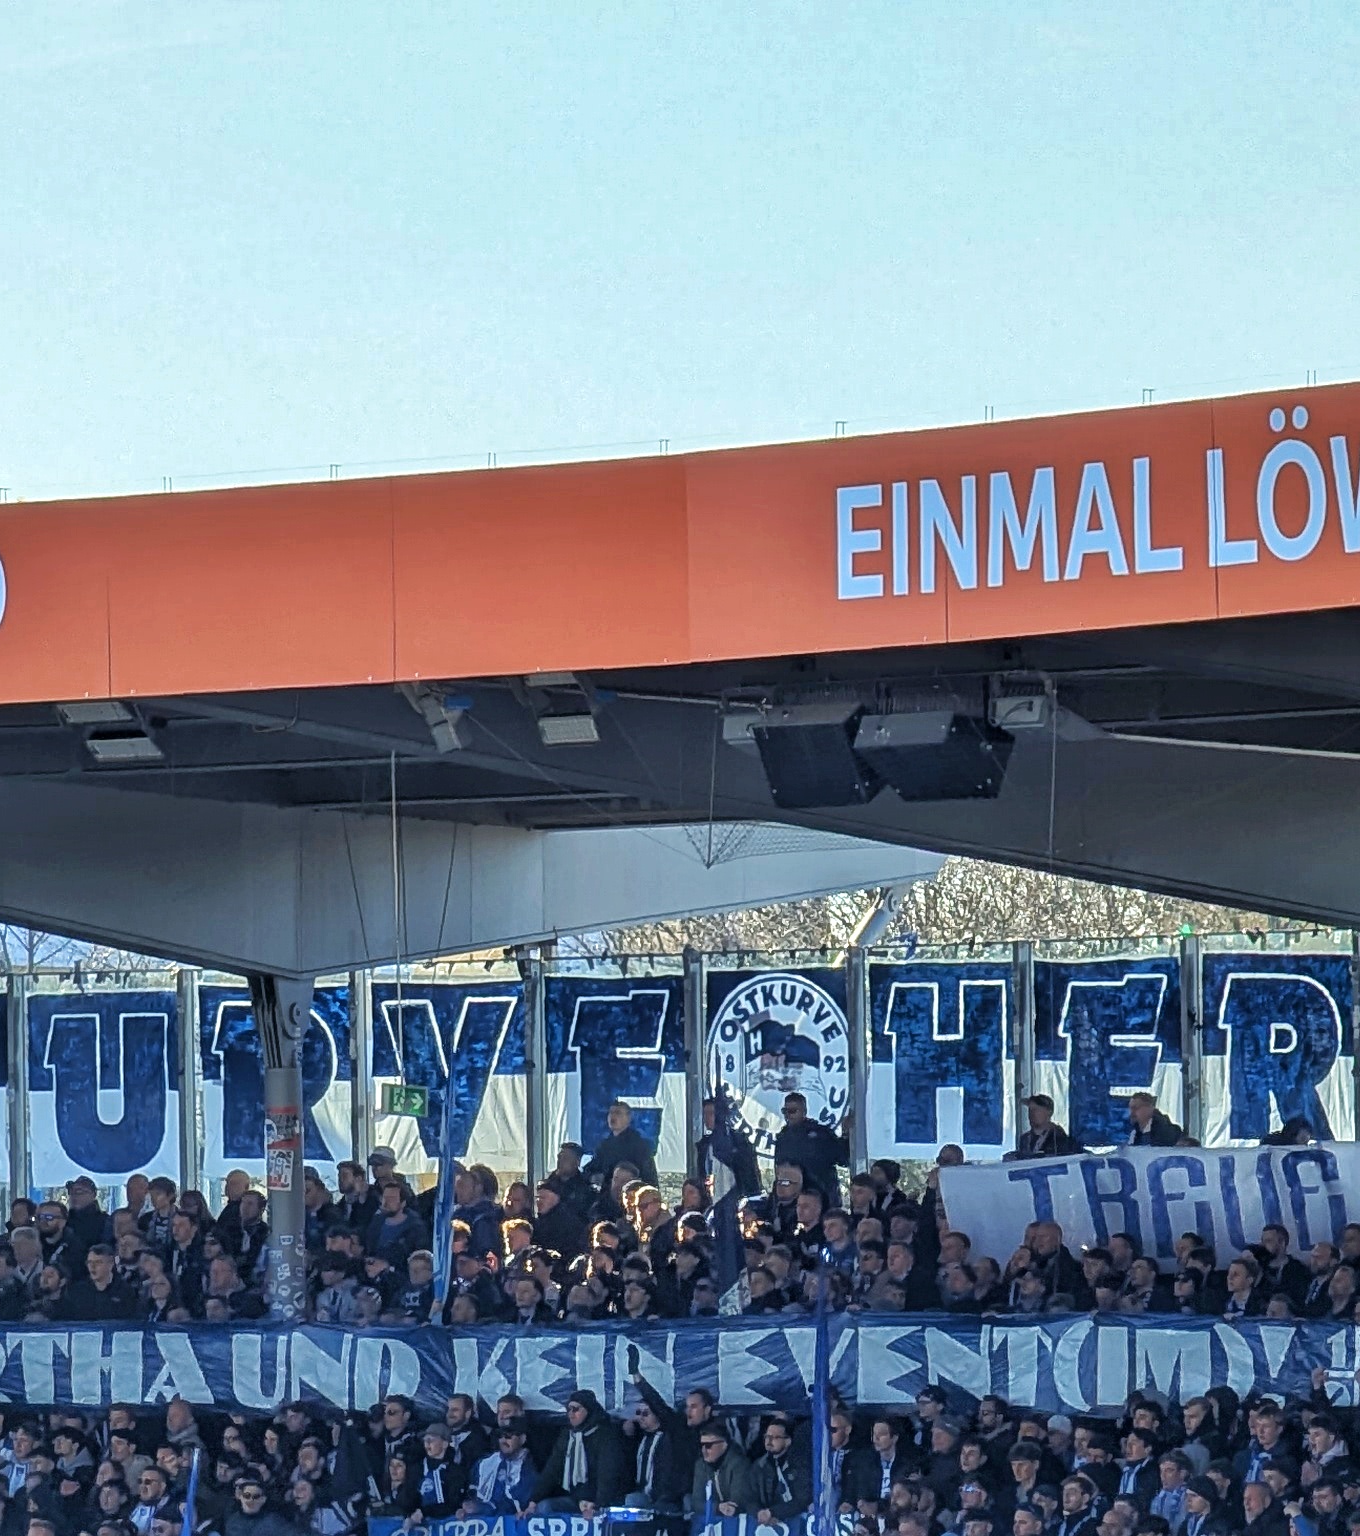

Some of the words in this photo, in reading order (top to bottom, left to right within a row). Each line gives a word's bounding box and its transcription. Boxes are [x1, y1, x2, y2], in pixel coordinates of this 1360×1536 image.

[836, 455, 1182, 599] EINMAL
[720, 983, 842, 1043] OSTKURVE
[823, 1055, 846, 1073] 92
[1009, 1148, 1347, 1258] TREUE
[232, 1332, 421, 1412] UND
[453, 1332, 676, 1414] KEIN
